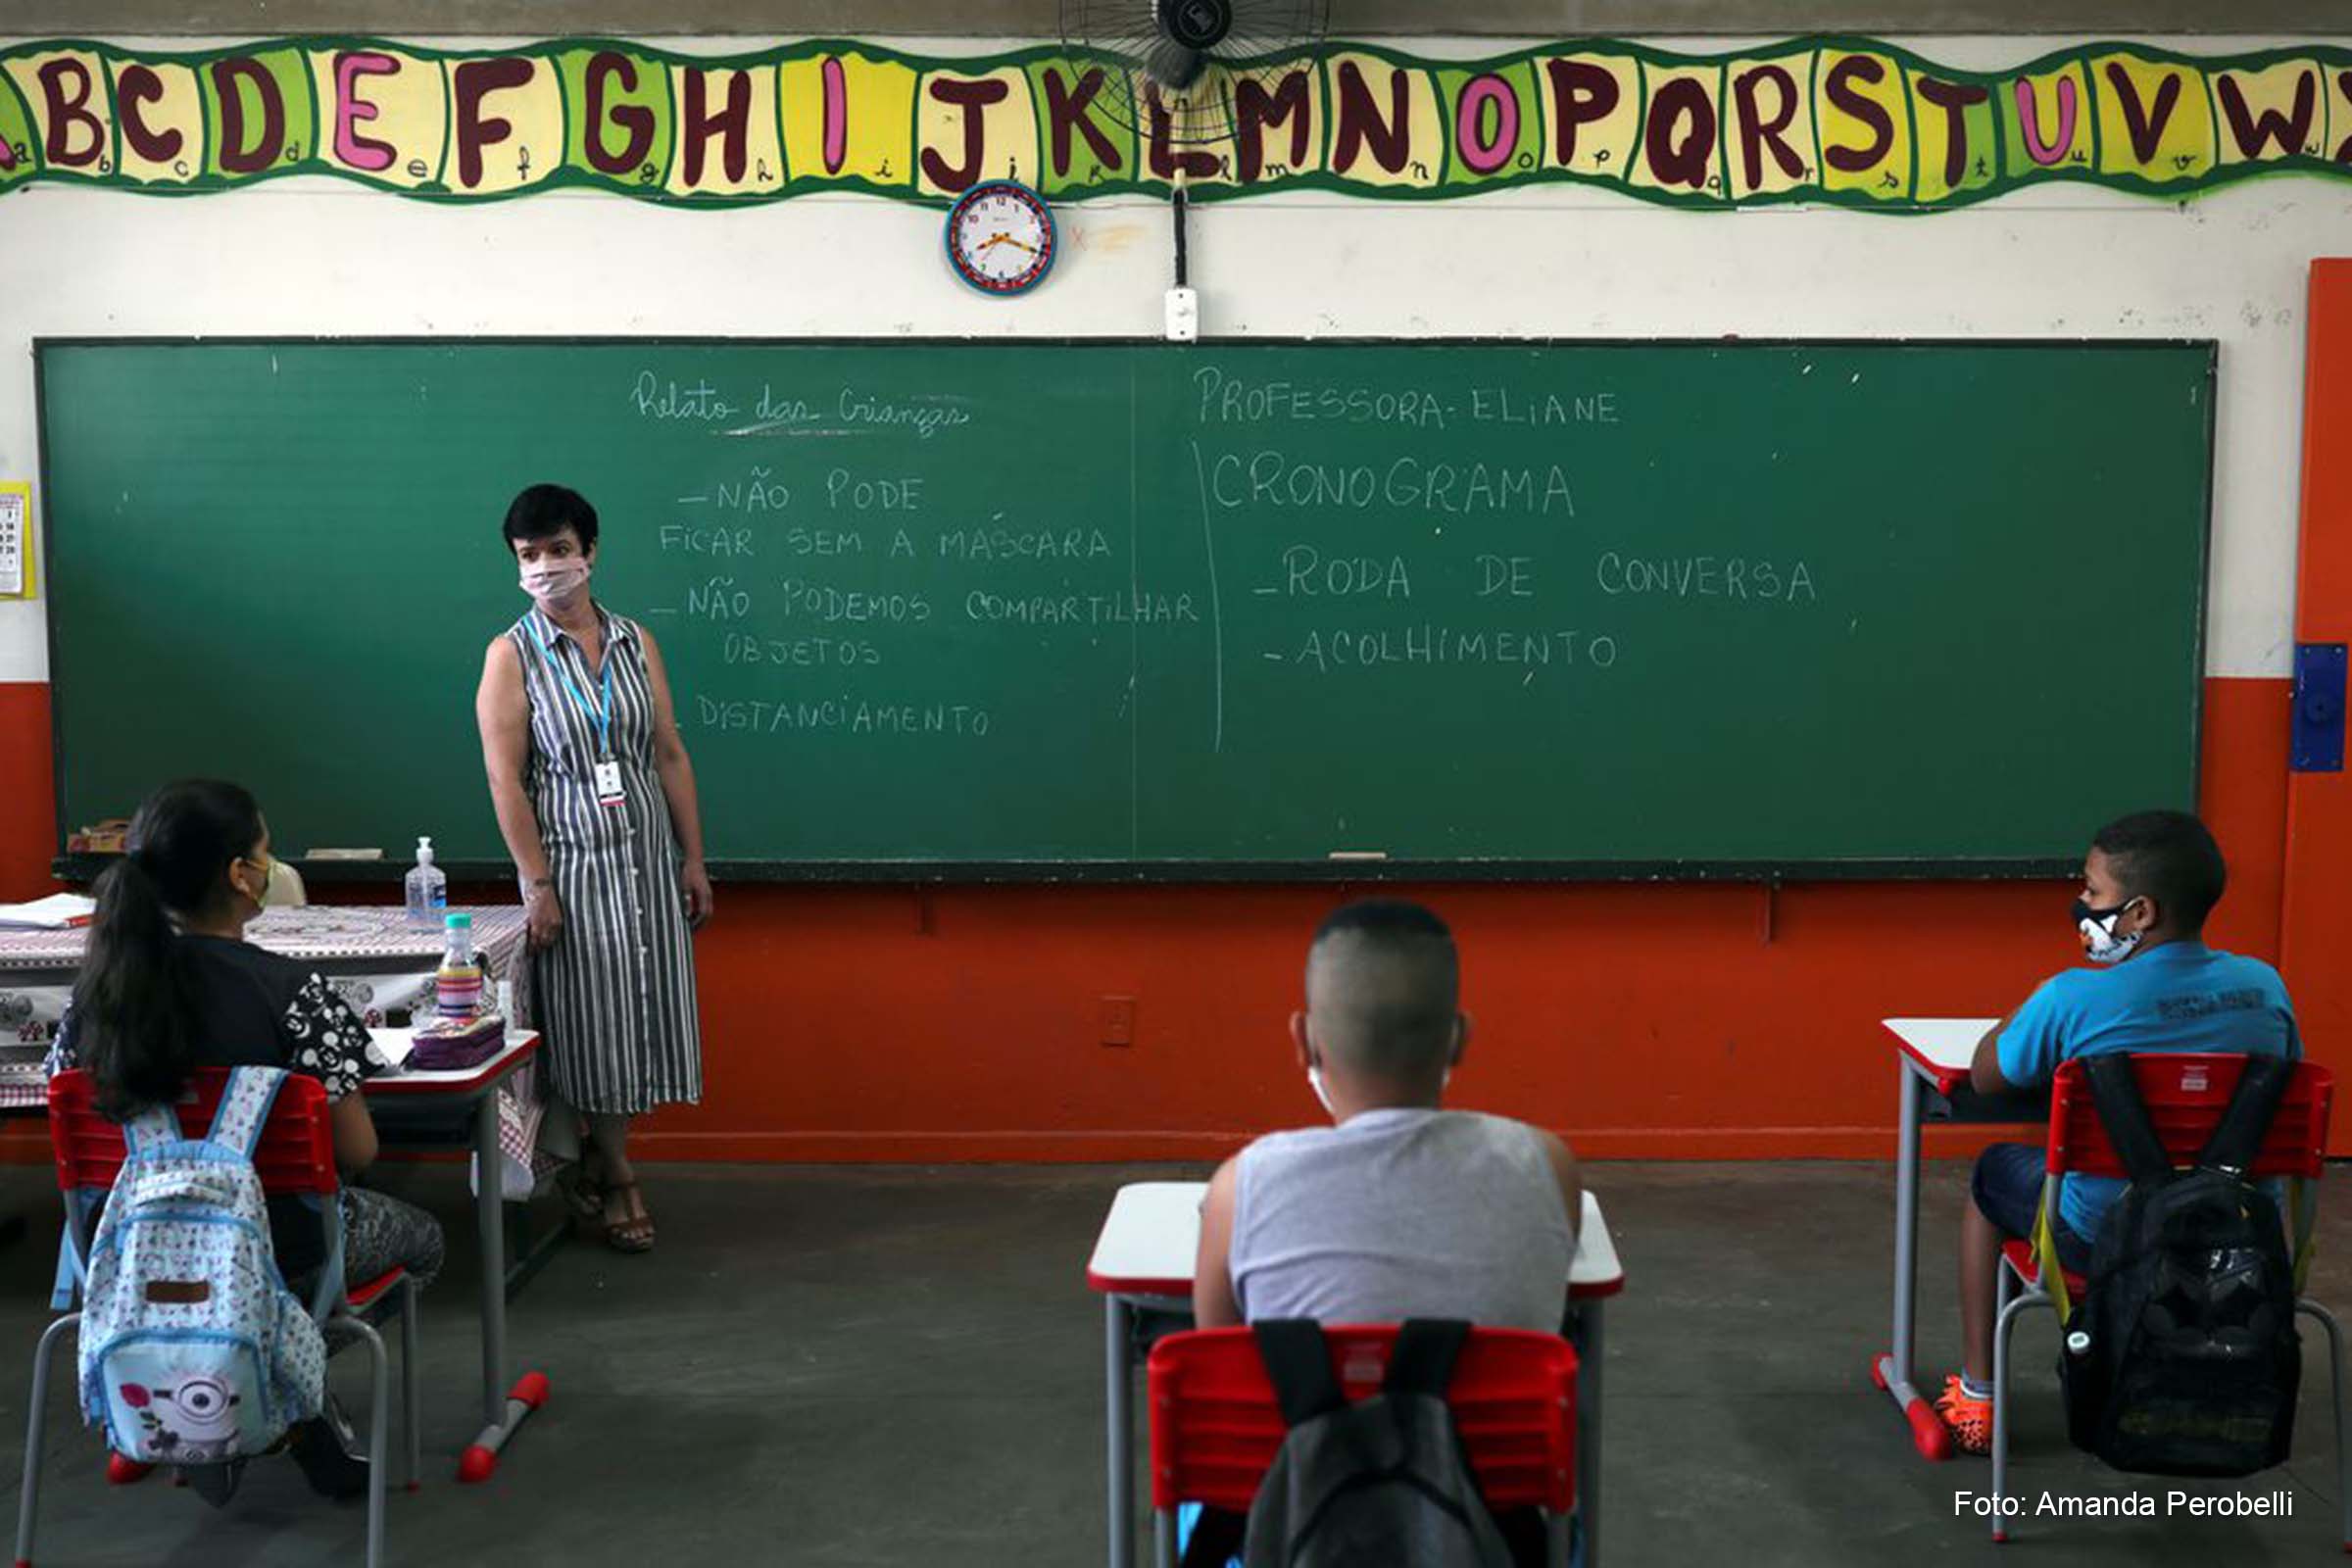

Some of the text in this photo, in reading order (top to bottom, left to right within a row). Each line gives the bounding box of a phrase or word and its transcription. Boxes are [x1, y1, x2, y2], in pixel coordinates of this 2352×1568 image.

[37, 58, 105, 166] B
[119, 65, 183, 162] C
[211, 56, 285, 172] D
[332, 52, 401, 172] E
[455, 58, 534, 187] F
[584, 50, 656, 173] G
[684, 64, 751, 186] H
[821, 56, 847, 174] I
[920, 78, 1008, 193] J
[1042, 68, 1122, 177] K
[1236, 71, 1309, 183] M
[1333, 60, 1409, 173] N
[1455, 73, 1521, 176] O
[1547, 58, 1620, 166] P
[1646, 77, 1716, 189] Q
[1734, 65, 1804, 190] R
[1825, 54, 1894, 172] S
[1916, 75, 1987, 188] T
[2015, 75, 2077, 166] U
[2105, 62, 2180, 165] V
[2218, 71, 2315, 159] W
[630, 370, 739, 419] Relato
[827, 468, 923, 510] PODE
[1213, 452, 1575, 516] CRONOGRAMA
[789, 528, 862, 555] SEM
[891, 528, 914, 557] A
[940, 512, 1111, 560] MÁSCARA
[783, 577, 931, 620] PODEMOS
[1475, 555, 1534, 596] DE
[1597, 552, 1816, 601] CONVERSA
[724, 634, 879, 664] OBJETOS
